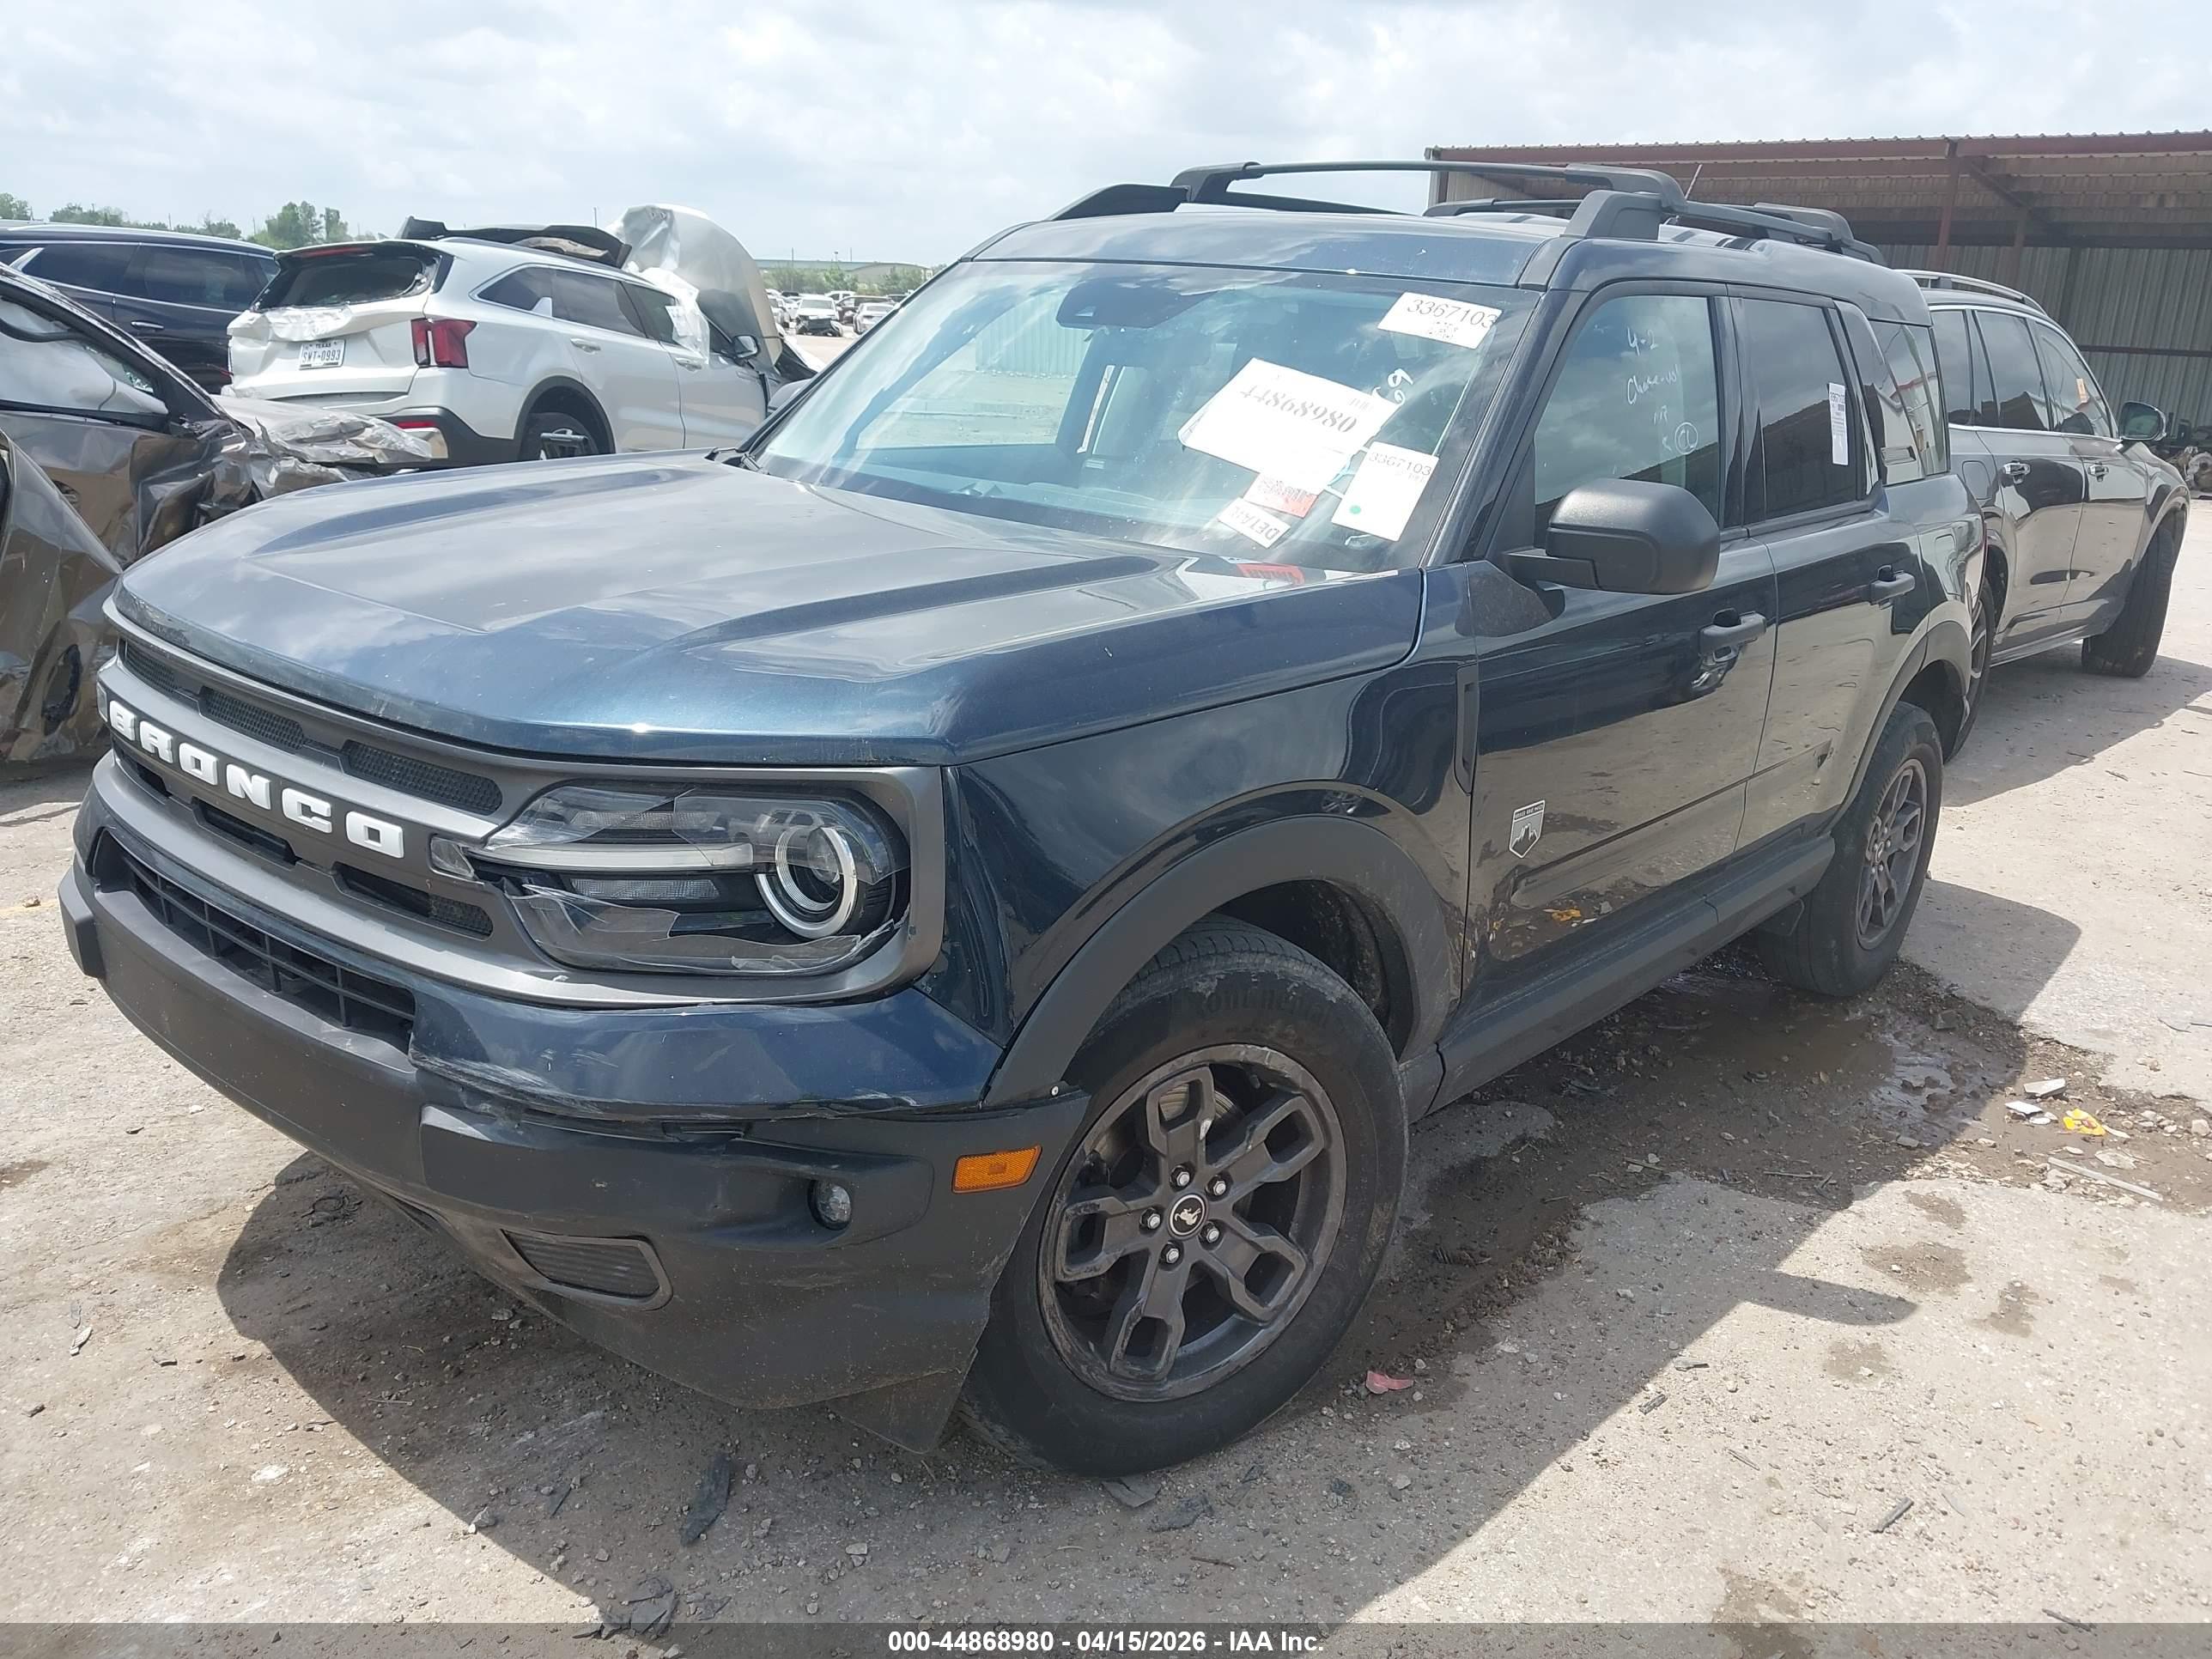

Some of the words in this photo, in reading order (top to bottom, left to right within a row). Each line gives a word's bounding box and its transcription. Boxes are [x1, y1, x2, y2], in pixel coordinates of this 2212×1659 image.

[1407, 299, 1498, 328] 3367103
[1239, 385, 1357, 433] 44868980
[109, 700, 404, 859] BRONCO
